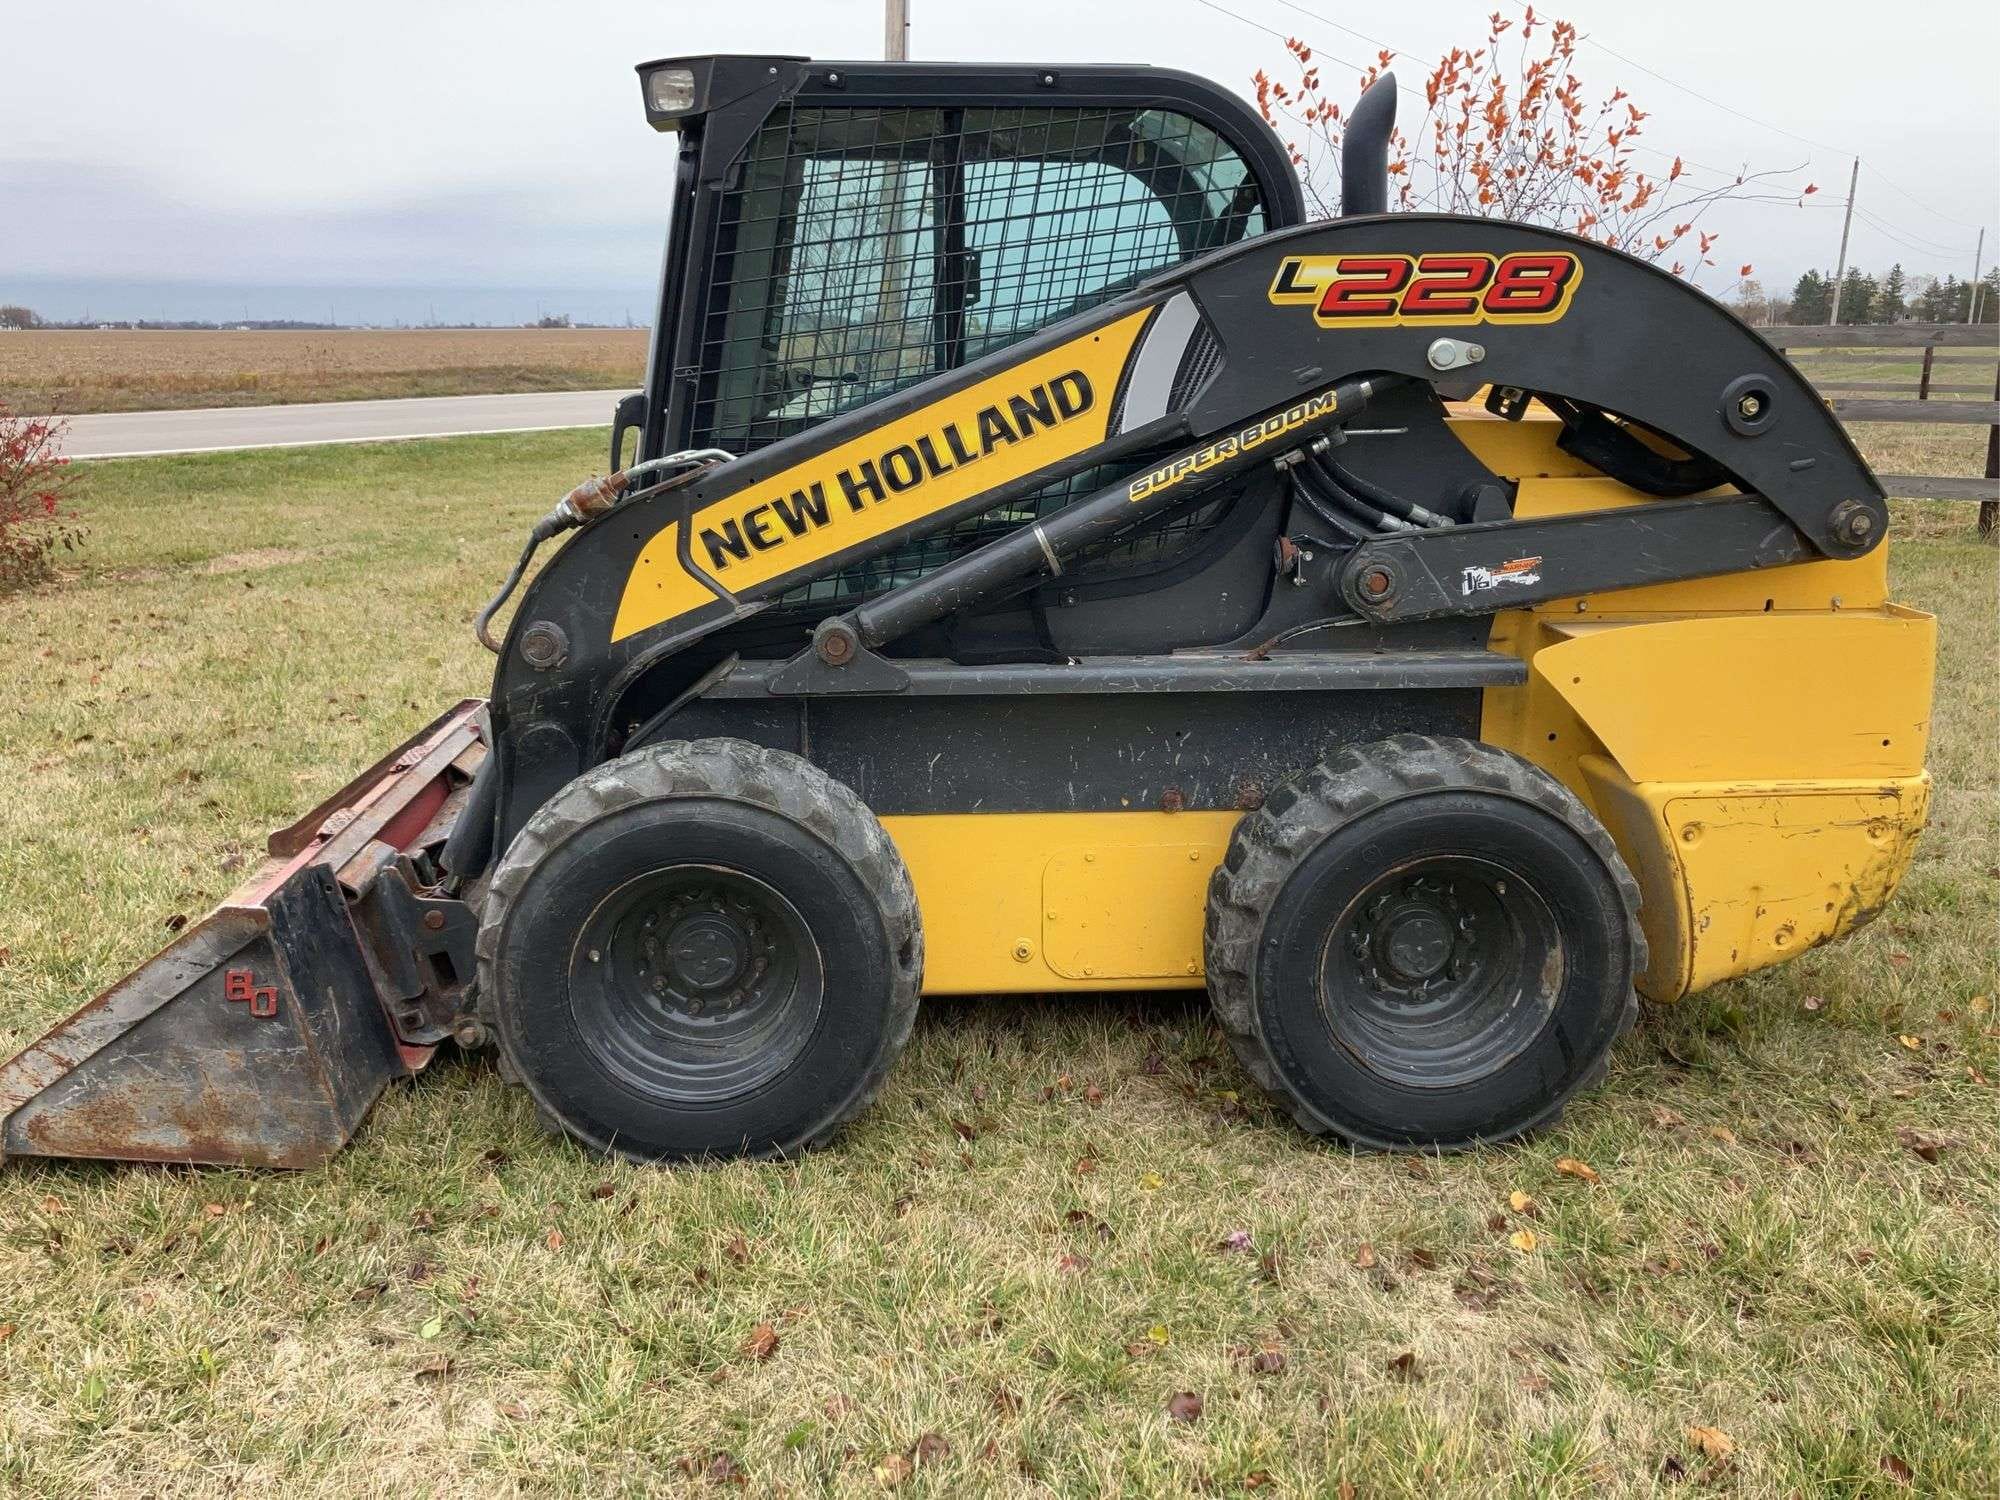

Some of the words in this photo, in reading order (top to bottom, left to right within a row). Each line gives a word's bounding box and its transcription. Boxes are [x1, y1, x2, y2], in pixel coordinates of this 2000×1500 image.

[1270, 254, 1578, 323] L228
[700, 481, 833, 572] NEW
[836, 369, 1096, 512] HOLLAND
[1129, 437, 1238, 501] SUPER
[1240, 390, 1338, 450] BOOM
